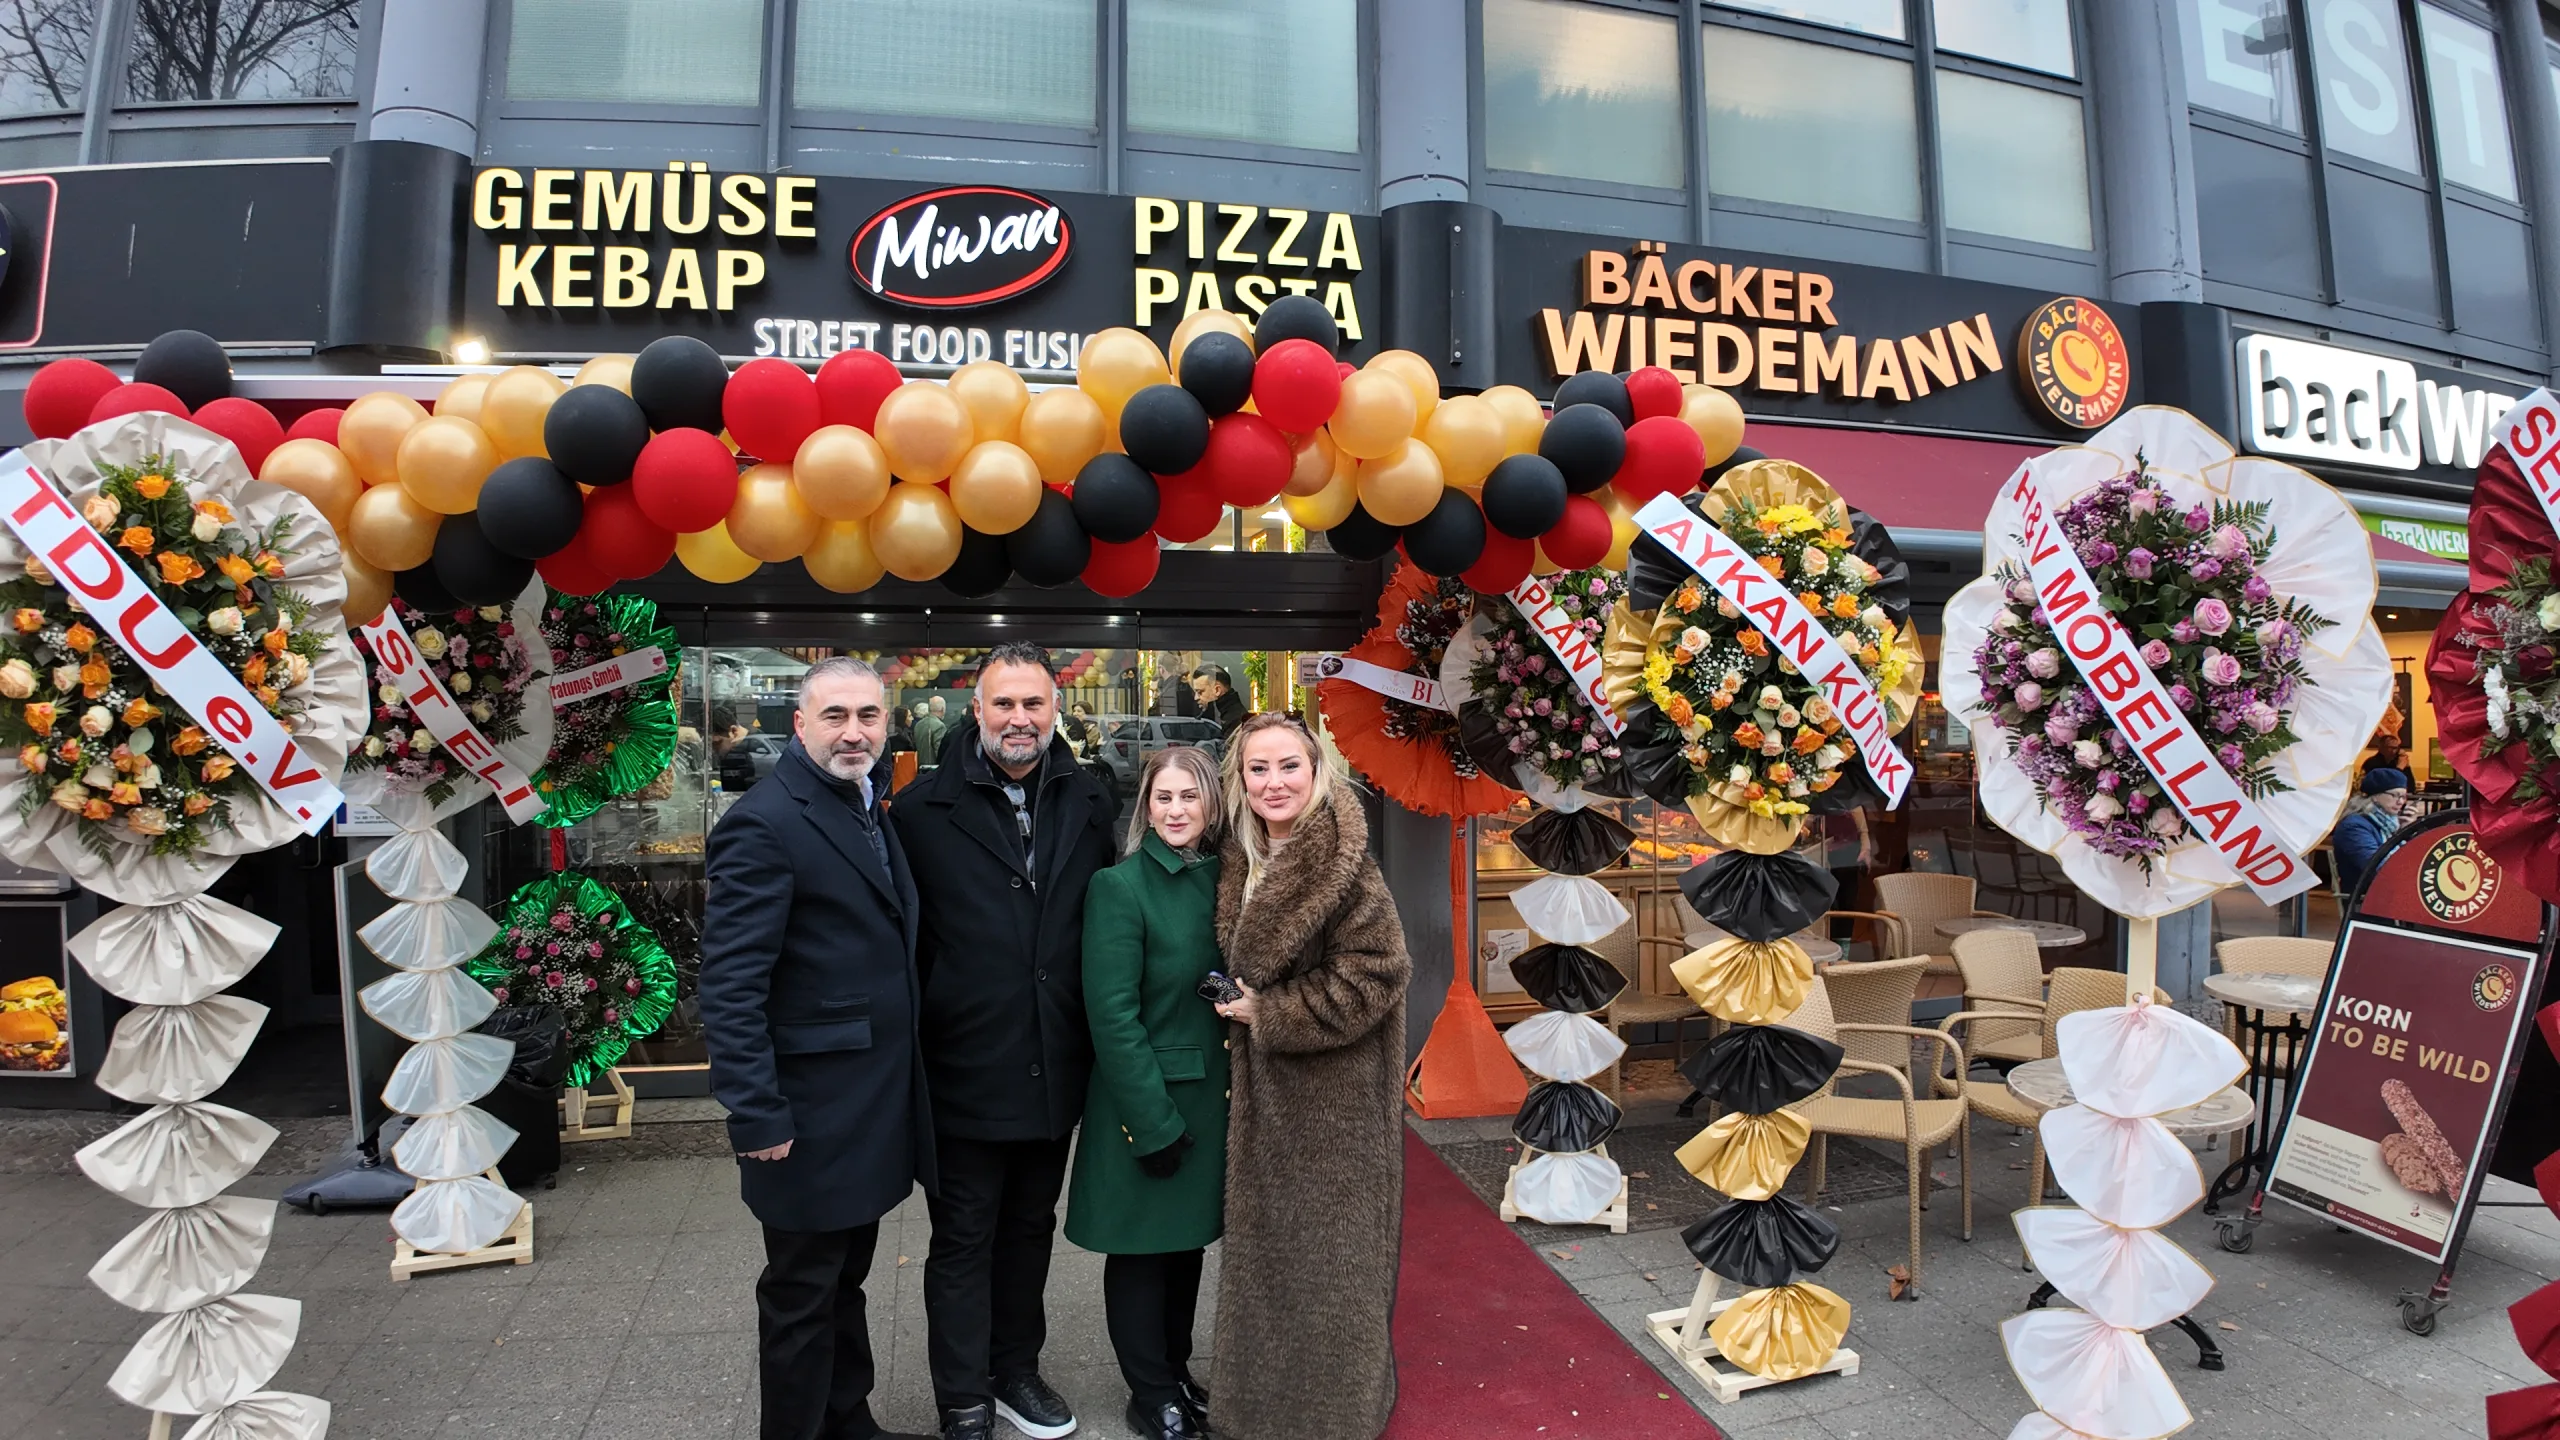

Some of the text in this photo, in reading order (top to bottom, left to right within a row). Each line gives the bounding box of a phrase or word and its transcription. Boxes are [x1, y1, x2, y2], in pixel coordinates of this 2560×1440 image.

[473, 160, 817, 238] GEMÜSE
[870, 204, 1060, 293] Miwan
[1135, 197, 1363, 271] PIZZA
[497, 245, 765, 311] KEBAP
[1586, 240, 1839, 326] BÄCKER
[754, 318, 880, 358] STREET
[893, 323, 991, 364] FOOD
[1541, 307, 2003, 401] WIEDEMANN
[2038, 305, 2115, 350] BÄCKER
[2035, 352, 2122, 421] WIEDEMANN
[1652, 518, 1825, 666] AYKAN
[12, 466, 321, 820] TDU e.V.
[367, 612, 448, 708] ST
[592, 664, 623, 688] GmbH
[2013, 469, 2295, 887] H&V MÖBELLAND
[2432, 837, 2495, 870] BÄCKER
[2423, 868, 2495, 918] WIEDEMANN
[2335, 994, 2412, 1032] KORN
[2473, 982, 2512, 1009] WIEDEMANN
[2330, 1021, 2491, 1083] TO BE WILD
